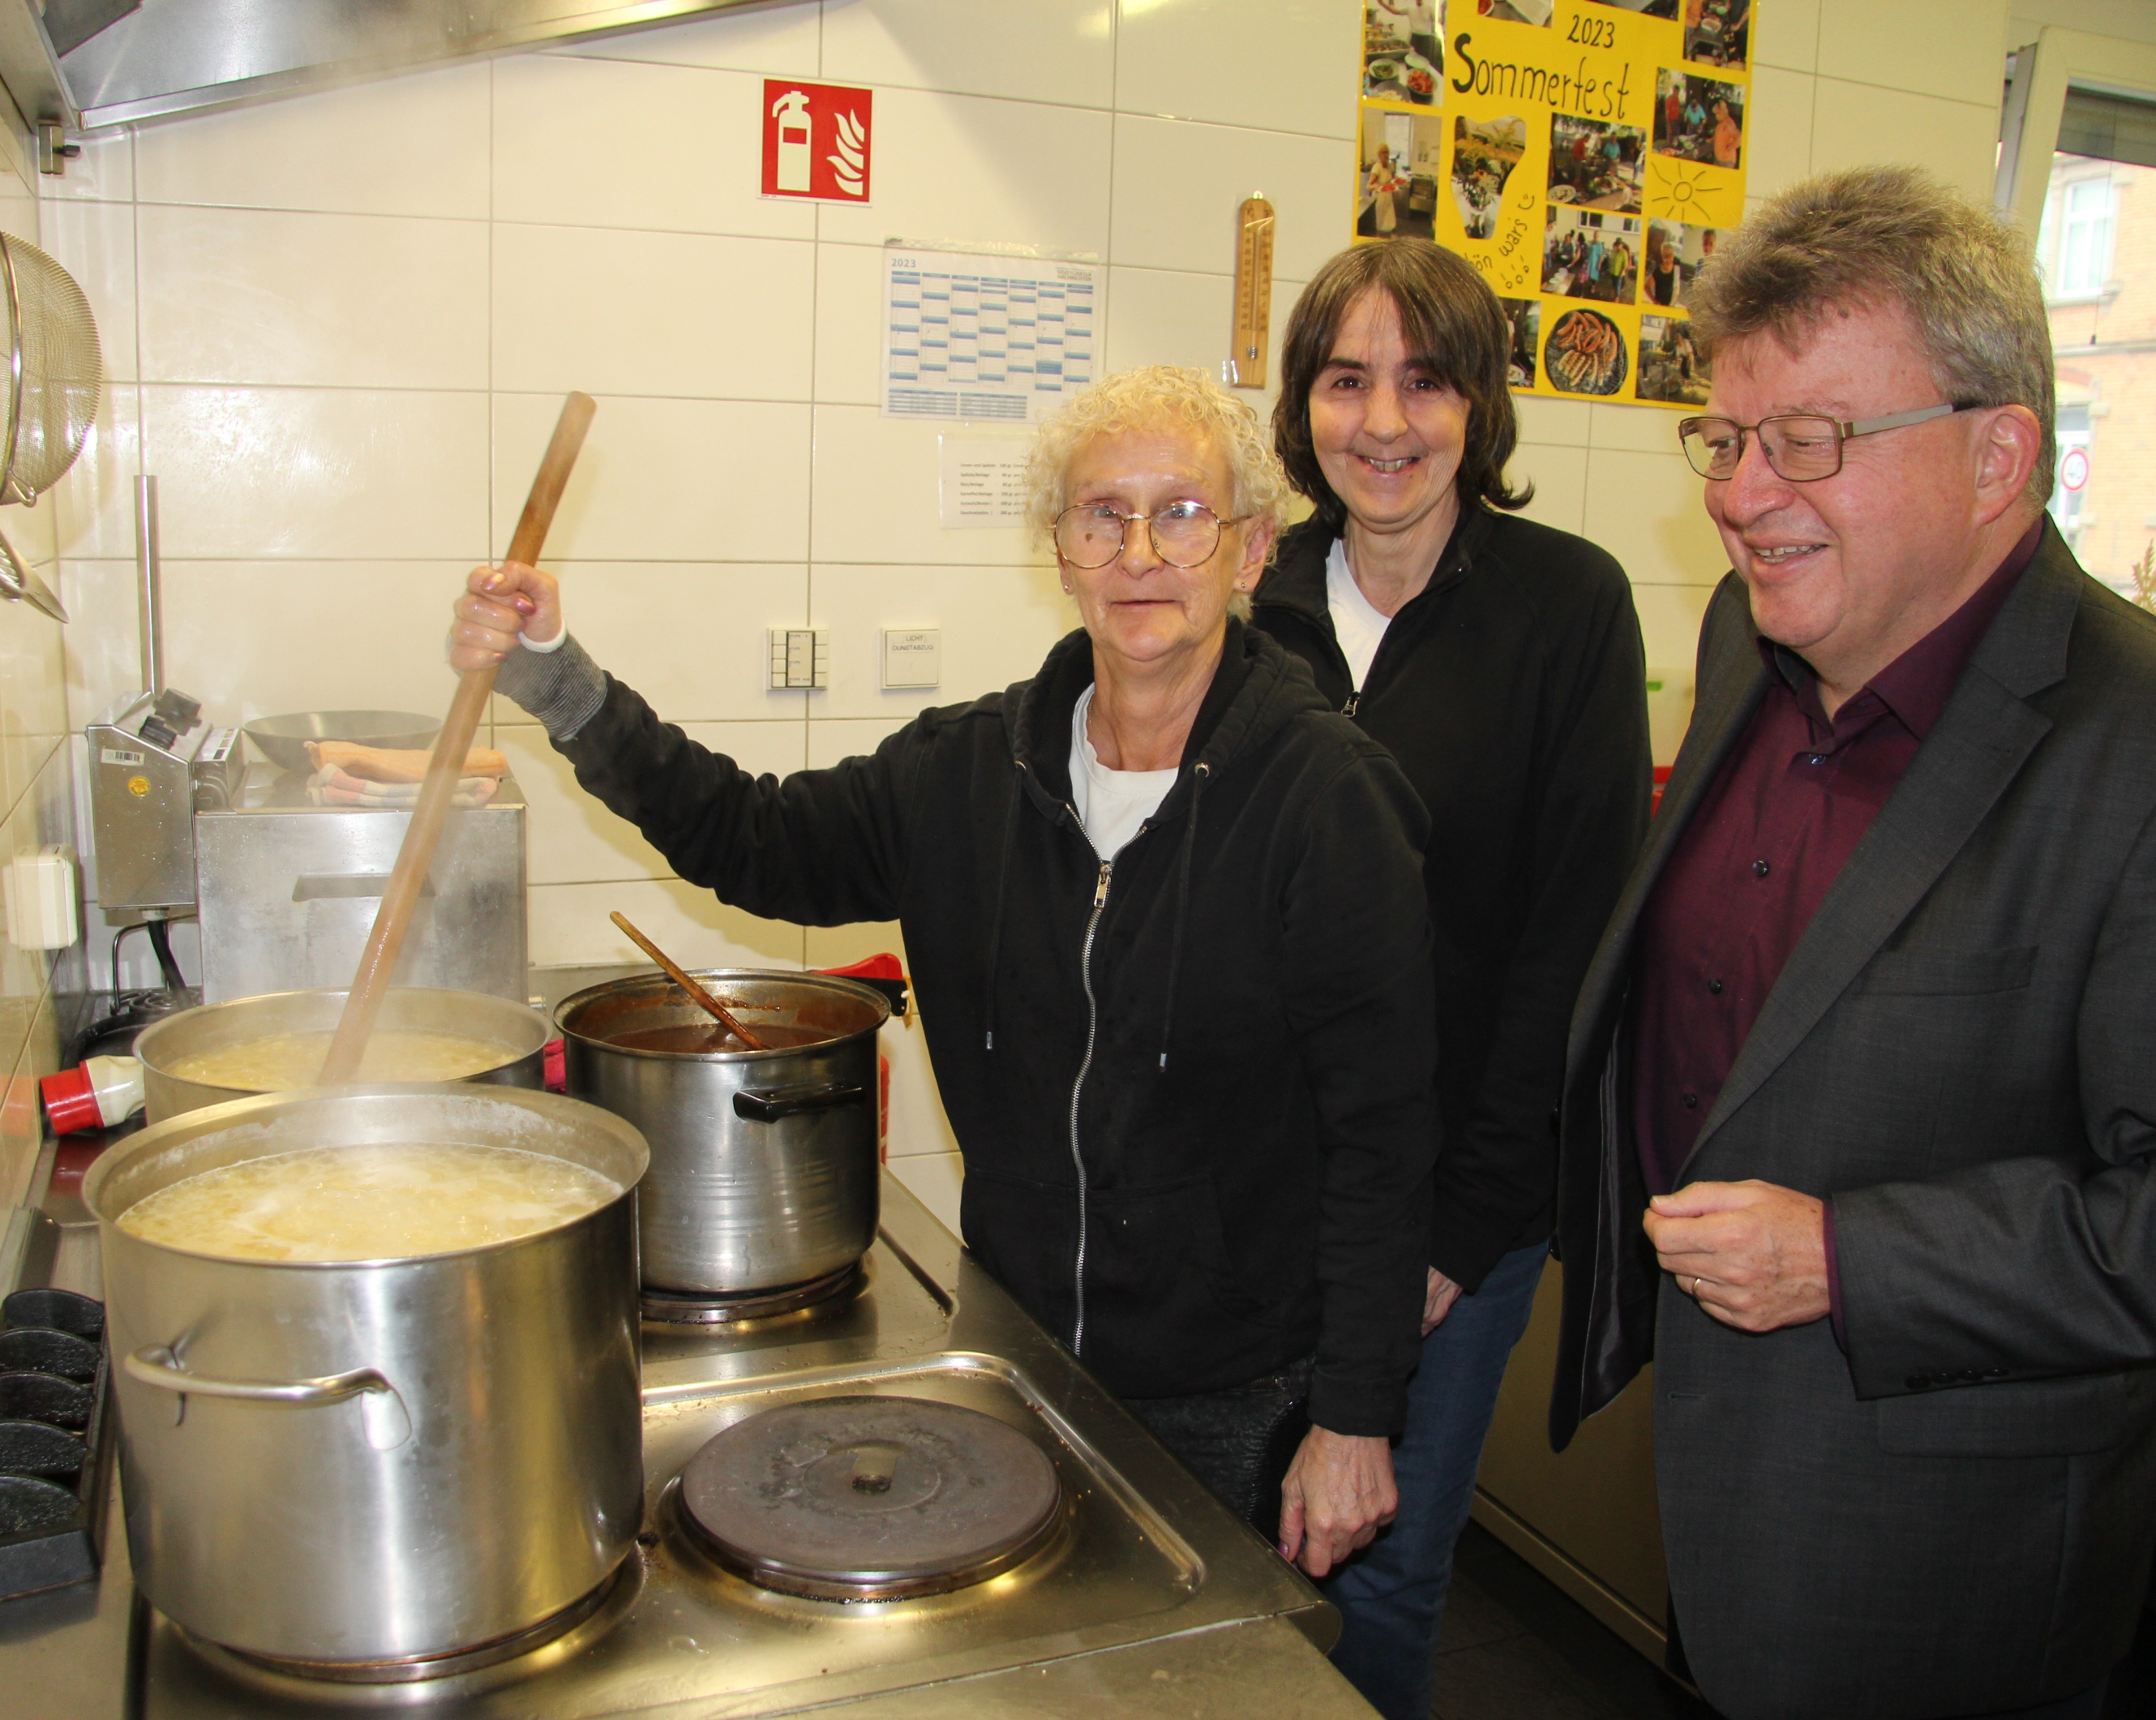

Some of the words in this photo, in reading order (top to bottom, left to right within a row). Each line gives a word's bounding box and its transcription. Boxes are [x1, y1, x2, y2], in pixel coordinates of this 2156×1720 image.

[1567, 14, 1615, 49] 2023
[1452, 32, 1630, 119] Sommerfest
[891, 258, 916, 268] 2023
